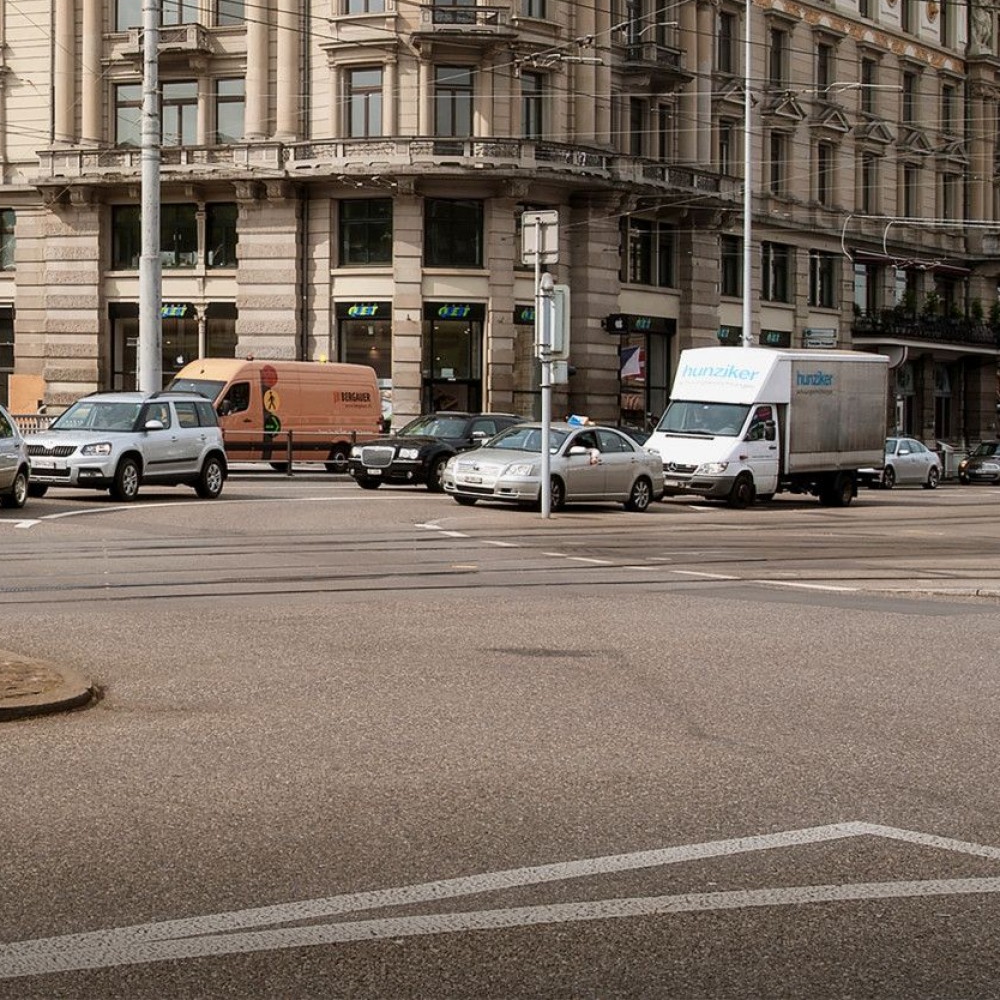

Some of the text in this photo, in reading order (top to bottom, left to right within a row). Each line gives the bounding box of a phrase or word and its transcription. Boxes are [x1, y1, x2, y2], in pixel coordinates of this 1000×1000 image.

[682, 364, 760, 381] hunziker
[796, 370, 833, 386] hunziker
[341, 391, 371, 403] BERGAUER
